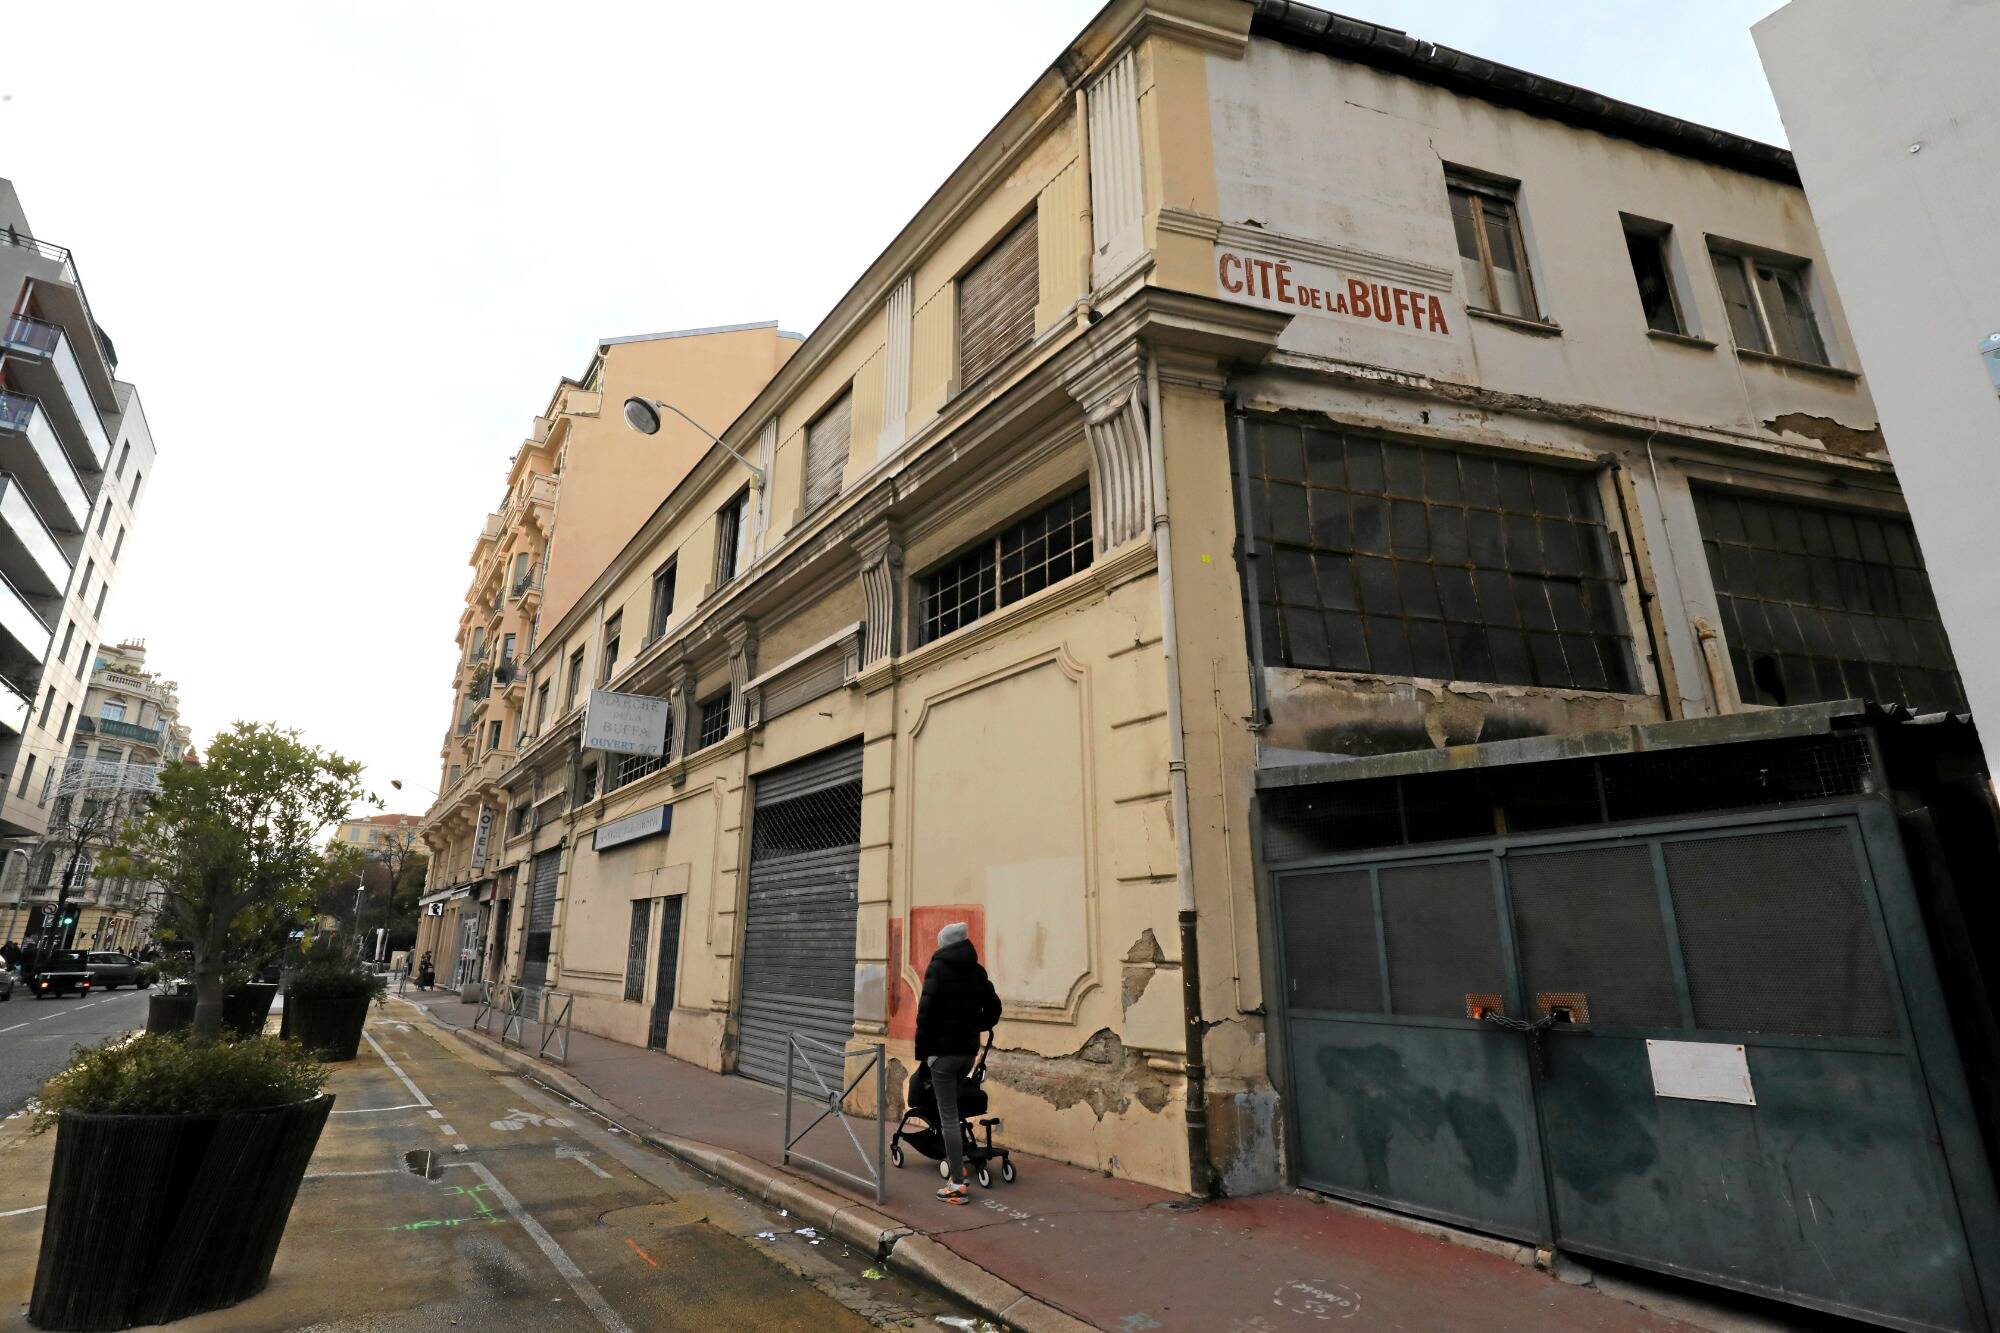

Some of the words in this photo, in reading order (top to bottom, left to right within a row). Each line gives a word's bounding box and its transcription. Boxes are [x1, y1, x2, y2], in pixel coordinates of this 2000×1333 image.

[1219, 253, 1295, 304] CITÉ
[1298, 285, 1322, 310] DE
[1326, 292, 1349, 315] LA
[1348, 278, 1449, 335] BUFFA
[591, 737, 635, 750] OUVERT
[477, 804, 491, 857] HOTEL
